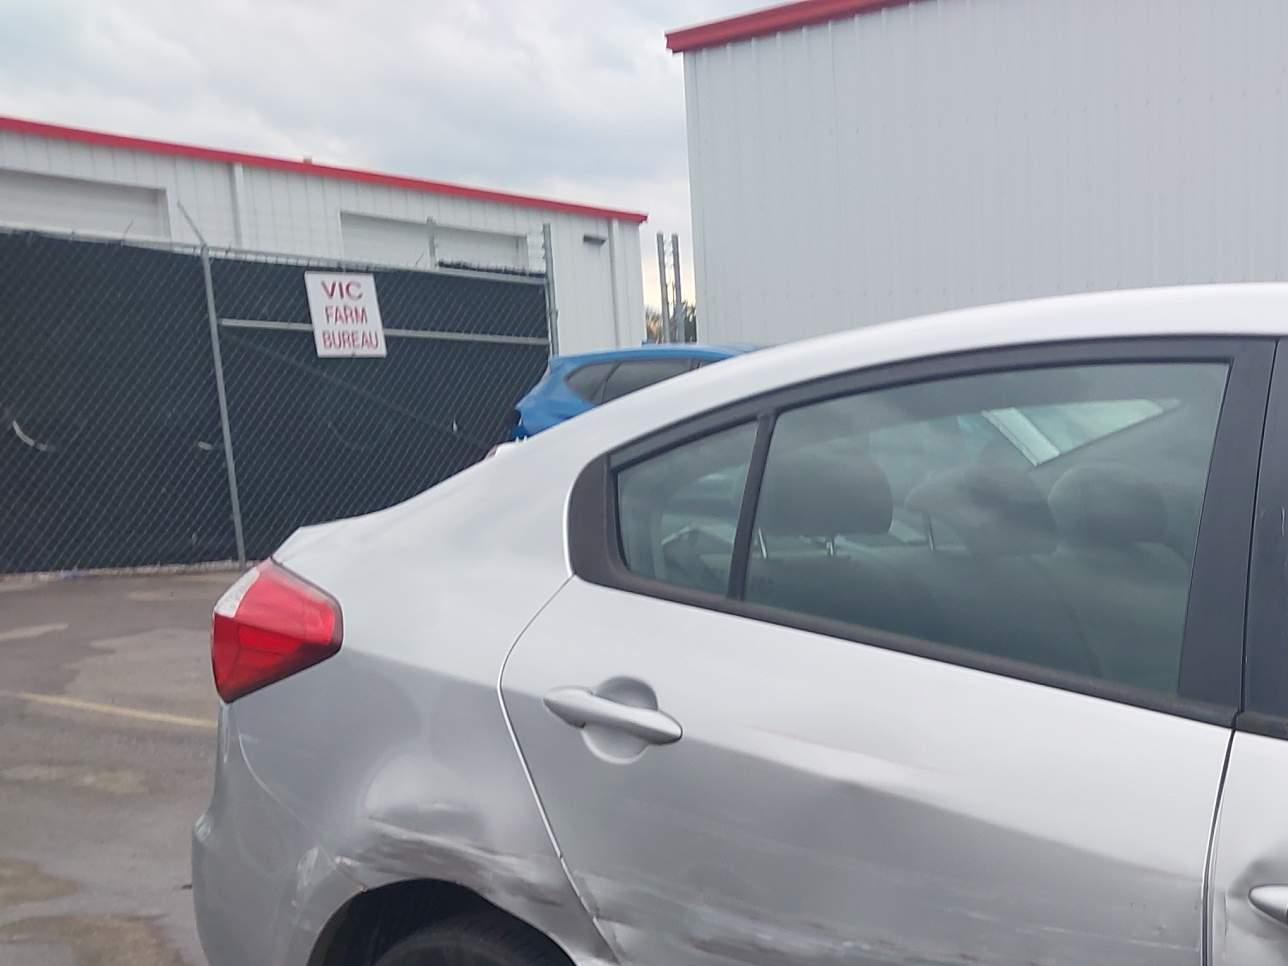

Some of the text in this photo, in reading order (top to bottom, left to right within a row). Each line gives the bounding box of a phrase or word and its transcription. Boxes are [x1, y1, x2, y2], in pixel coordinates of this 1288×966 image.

[321, 281, 363, 300] VIC
[325, 305, 368, 324] FARM
[322, 330, 379, 349] BUREAU
